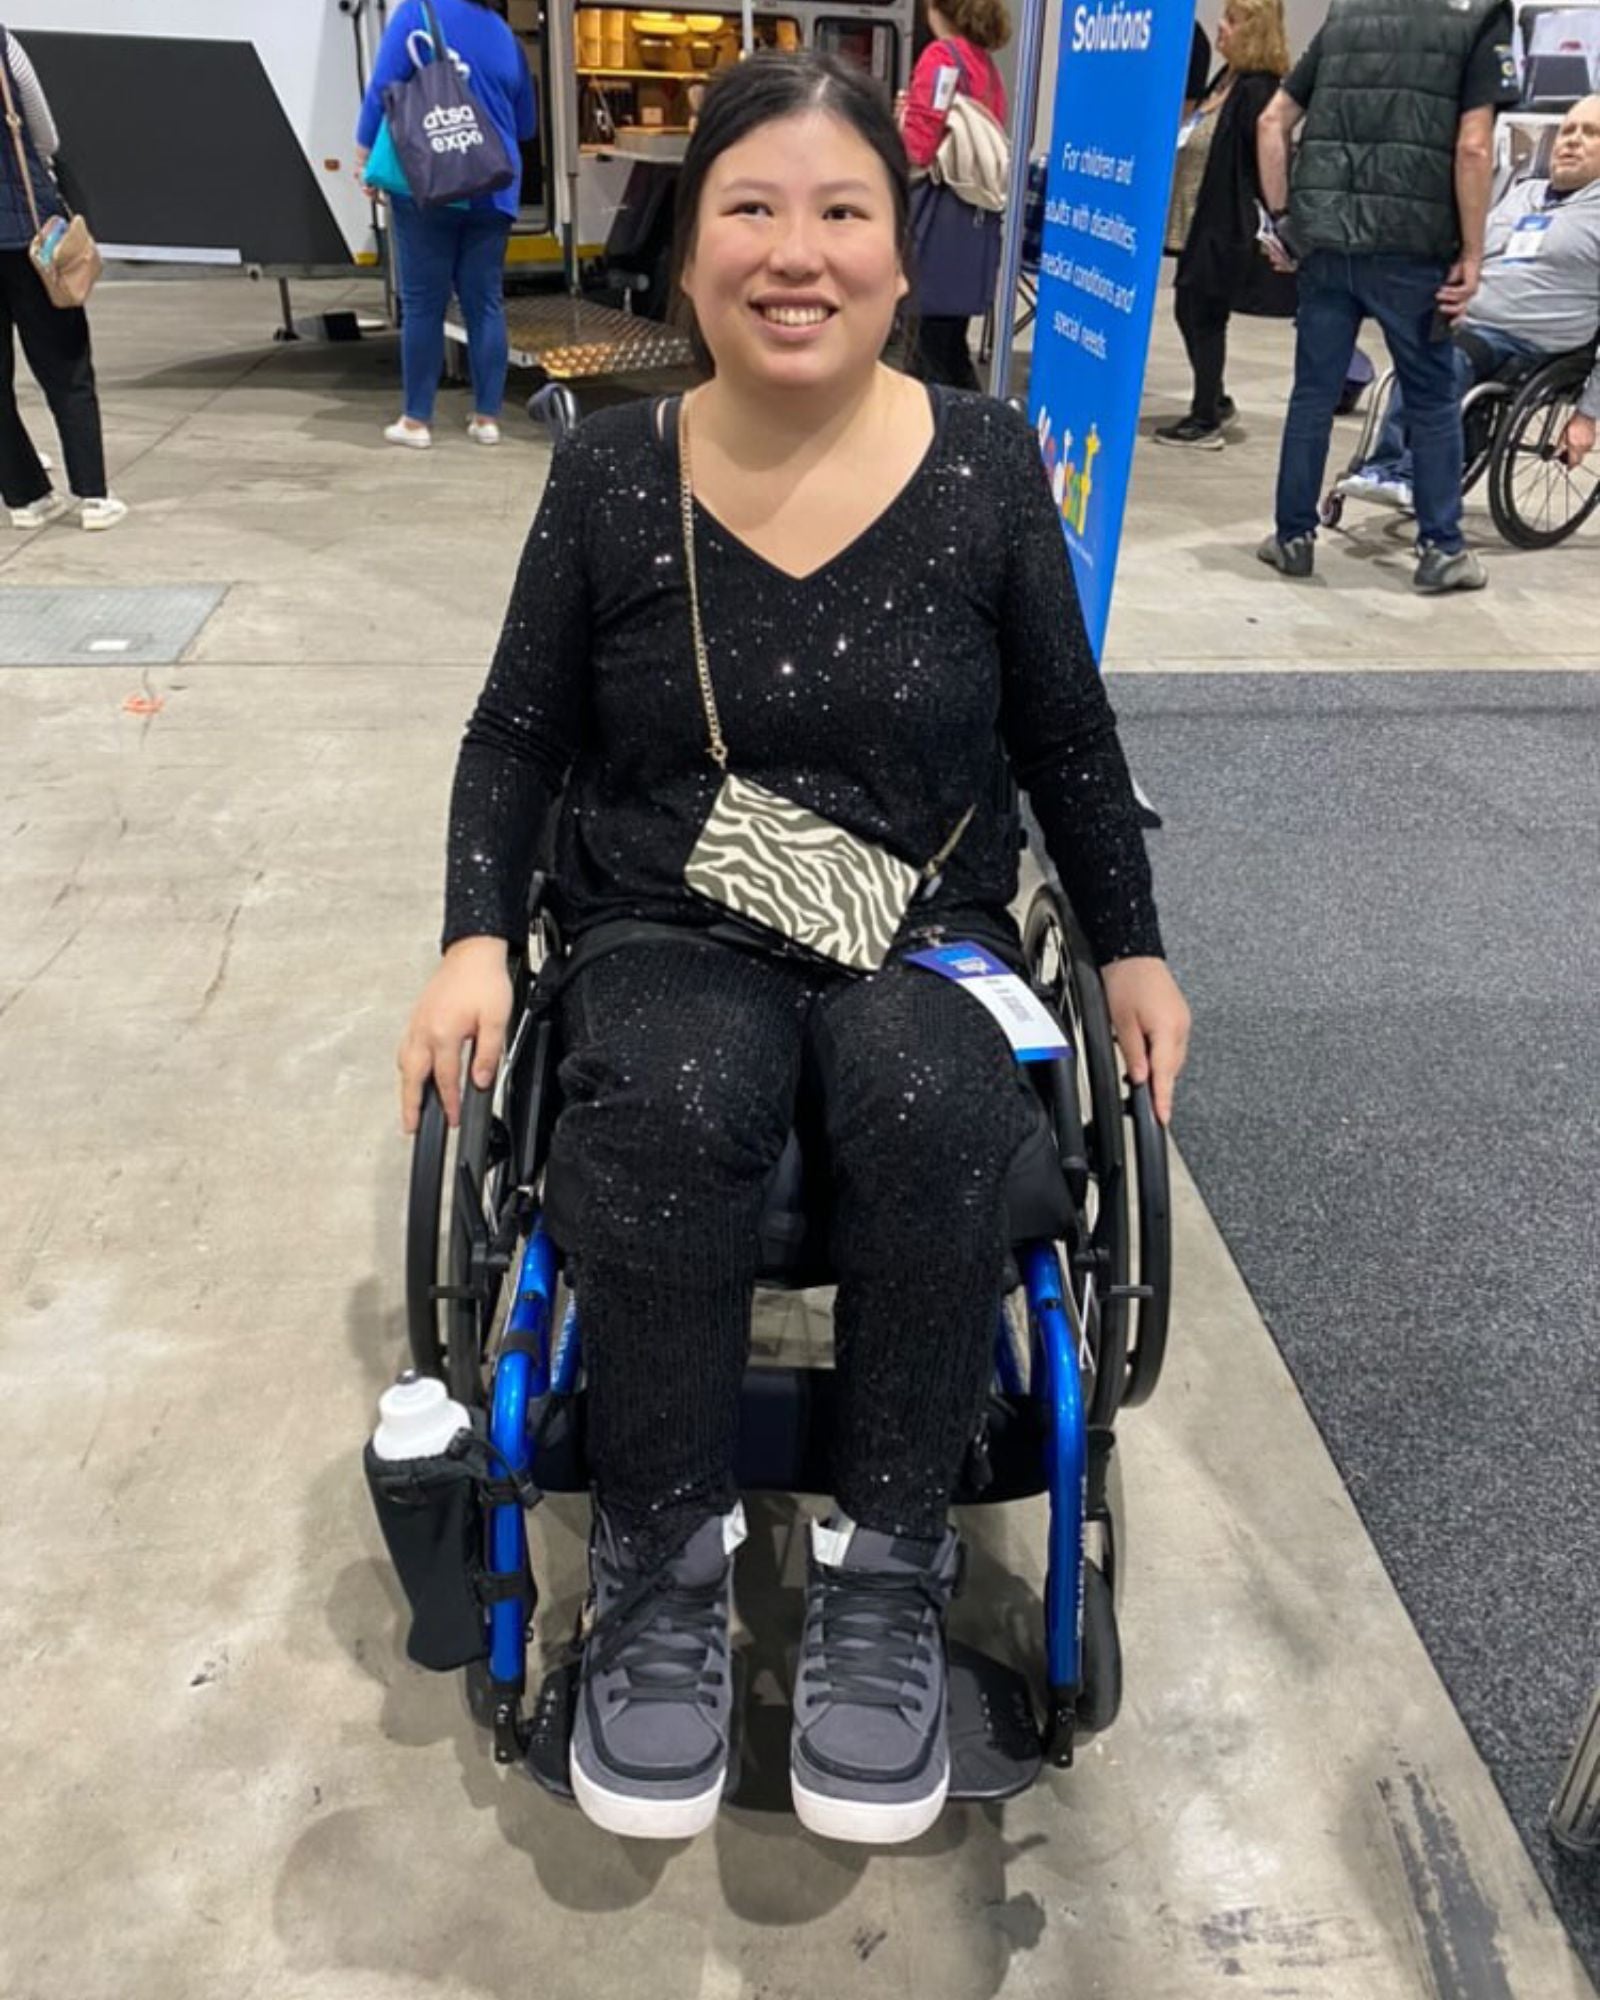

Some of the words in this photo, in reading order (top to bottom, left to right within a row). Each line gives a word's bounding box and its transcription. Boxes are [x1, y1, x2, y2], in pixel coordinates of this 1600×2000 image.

[1072, 0, 1152, 52] Solutions
[423, 104, 475, 130] atsa
[1062, 142, 1080, 171] For
[1080, 144, 1115, 179] children
[1115, 155, 1135, 185] and
[1072, 203, 1090, 232] with
[1073, 264, 1115, 304] conditions
[1114, 283, 1137, 314] and
[1053, 310, 1082, 343] special
